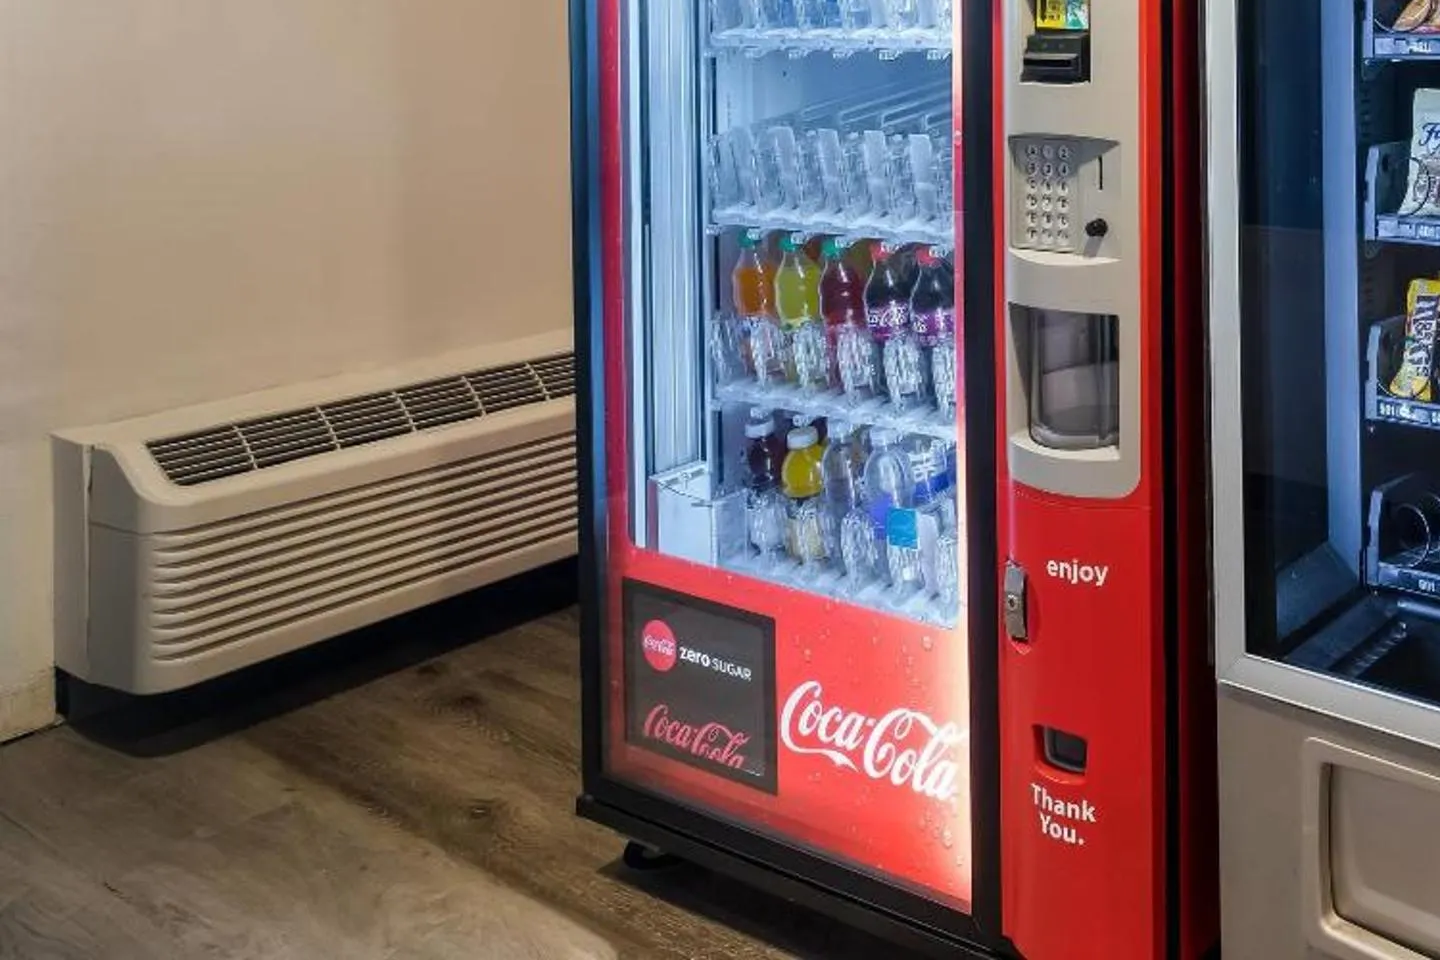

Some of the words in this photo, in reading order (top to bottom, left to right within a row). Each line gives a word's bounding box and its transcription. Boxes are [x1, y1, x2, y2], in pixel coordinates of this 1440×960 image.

[1047, 560, 1108, 586] enjoy
[679, 646, 711, 668] zero
[711, 657, 752, 683] SUGAR
[642, 704, 751, 770] Coca-Cola
[780, 680, 969, 801] Coca-Cola
[1030, 783, 1097, 823] Thank
[1039, 814, 1085, 845] You.
